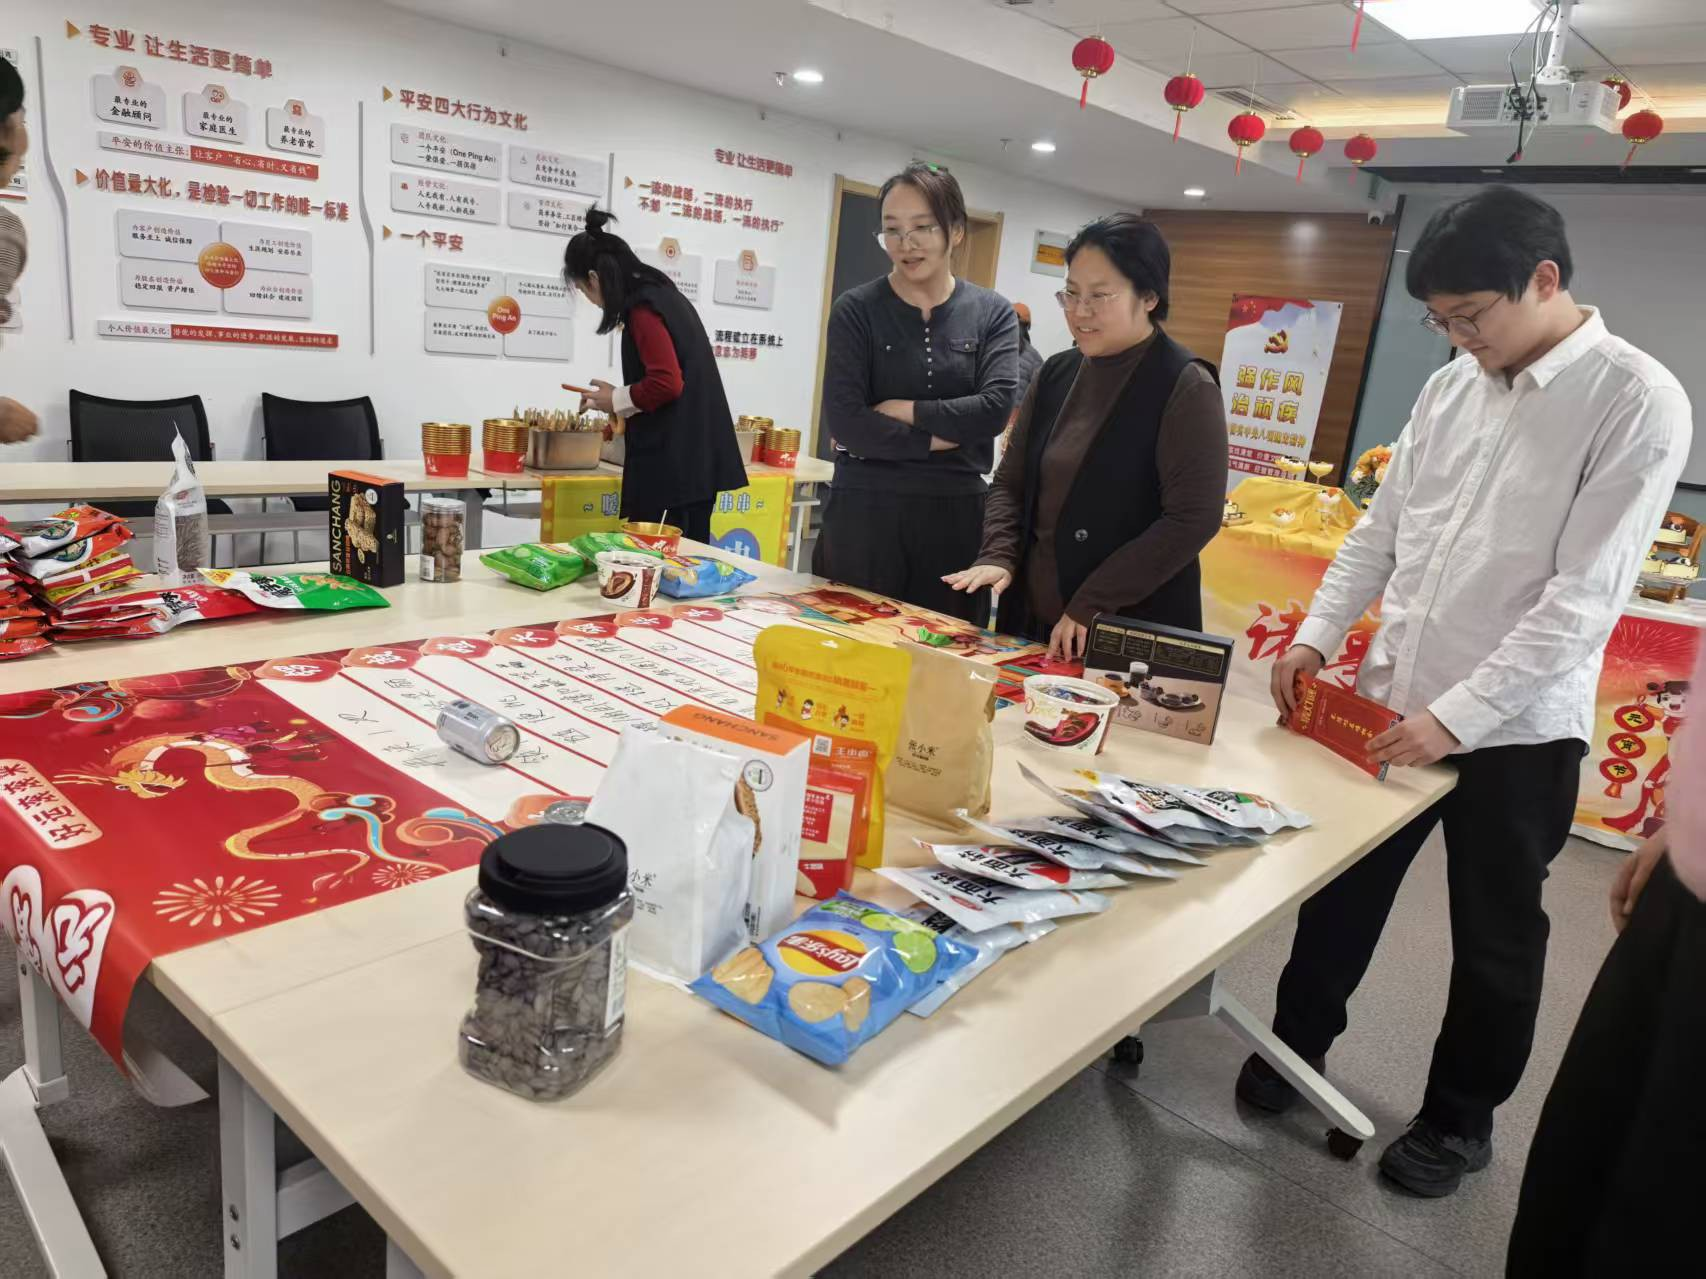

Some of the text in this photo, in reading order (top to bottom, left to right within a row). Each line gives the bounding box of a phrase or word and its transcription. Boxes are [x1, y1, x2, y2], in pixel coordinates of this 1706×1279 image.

[89, 24, 273, 79] 专业 让生活更简单
[114, 96, 147, 108] 最专业的
[400, 89, 528, 131] 平安四大行为文化
[110, 106, 152, 121] 金融顾问
[203, 112, 233, 123] 最专业的
[199, 121, 237, 136] 家庭医生
[284, 126, 311, 137] 最专业的
[281, 136, 314, 149] 养老管家
[468, 152, 483, 162] Ping
[714, 148, 734, 166] 专业
[400, 229, 464, 252] 一个平安
[715, 329, 784, 347] 流程建立在系统上
[1236, 364, 1305, 396] 强作风
[1231, 392, 1300, 424] 治顽疾
[713, 491, 750, 513] 串串
[331, 479, 343, 574] SANCHANG
[0, 763, 92, 843] 好运滚滚来
